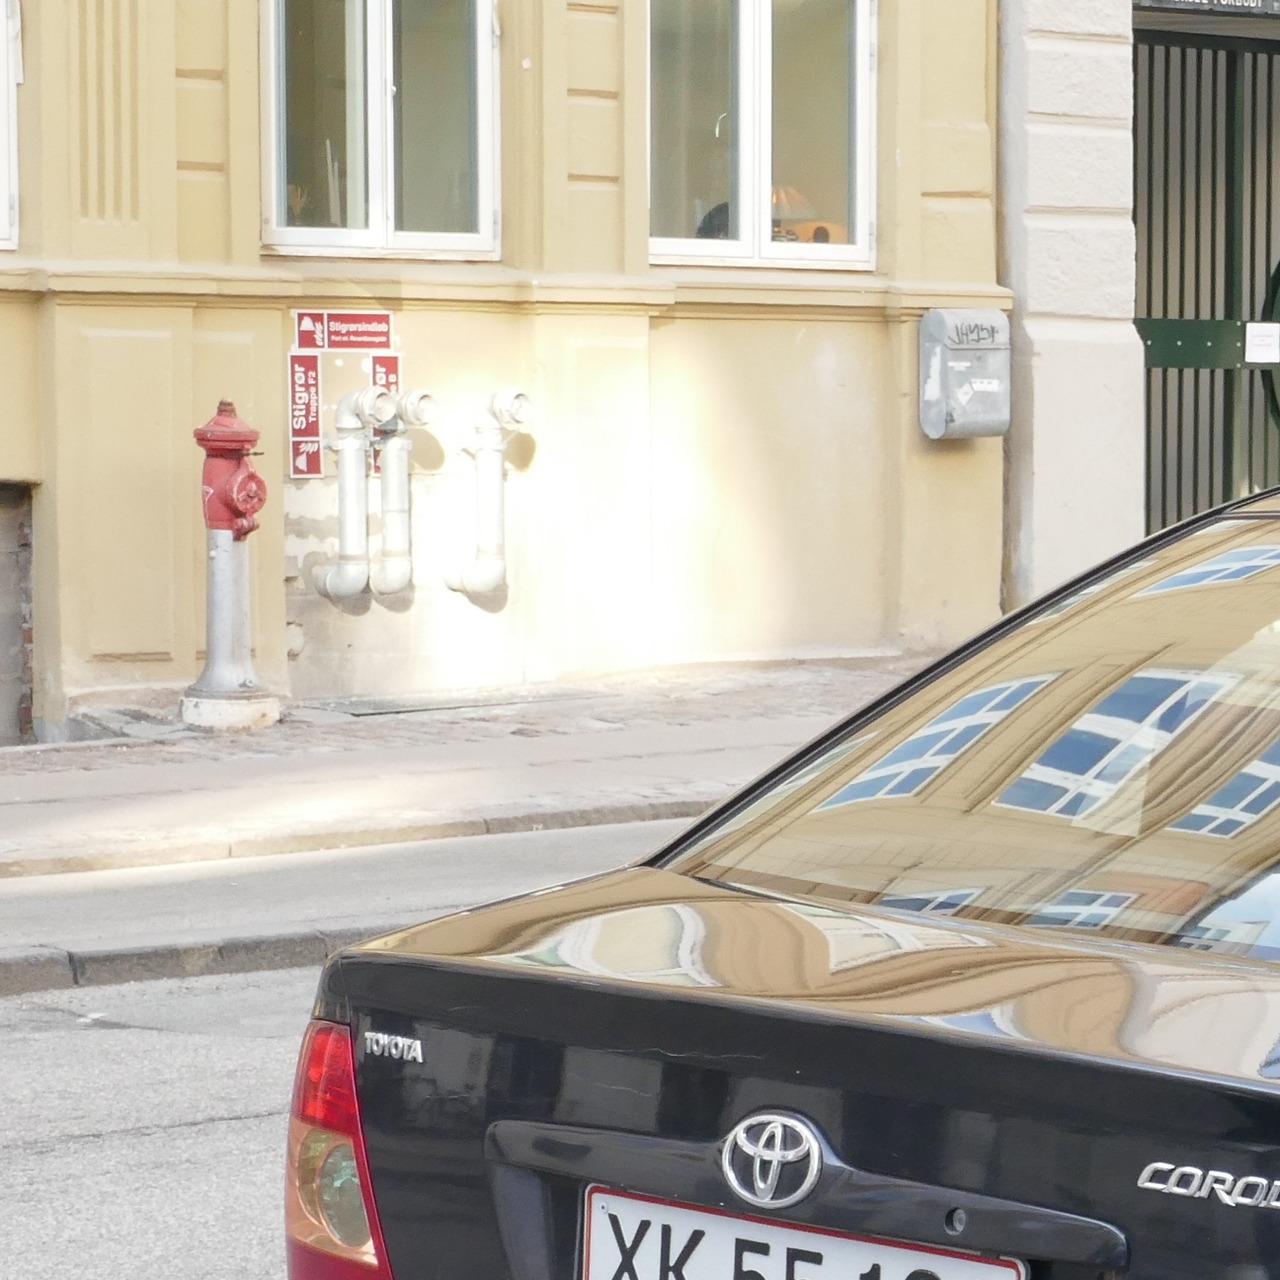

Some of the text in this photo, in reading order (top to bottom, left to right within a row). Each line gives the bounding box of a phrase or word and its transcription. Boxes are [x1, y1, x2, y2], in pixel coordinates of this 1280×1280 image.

[293, 364, 309, 430] Stigrør
[308, 371, 317, 423] Trappe F2
[364, 1031, 424, 1064] TOYOTA
